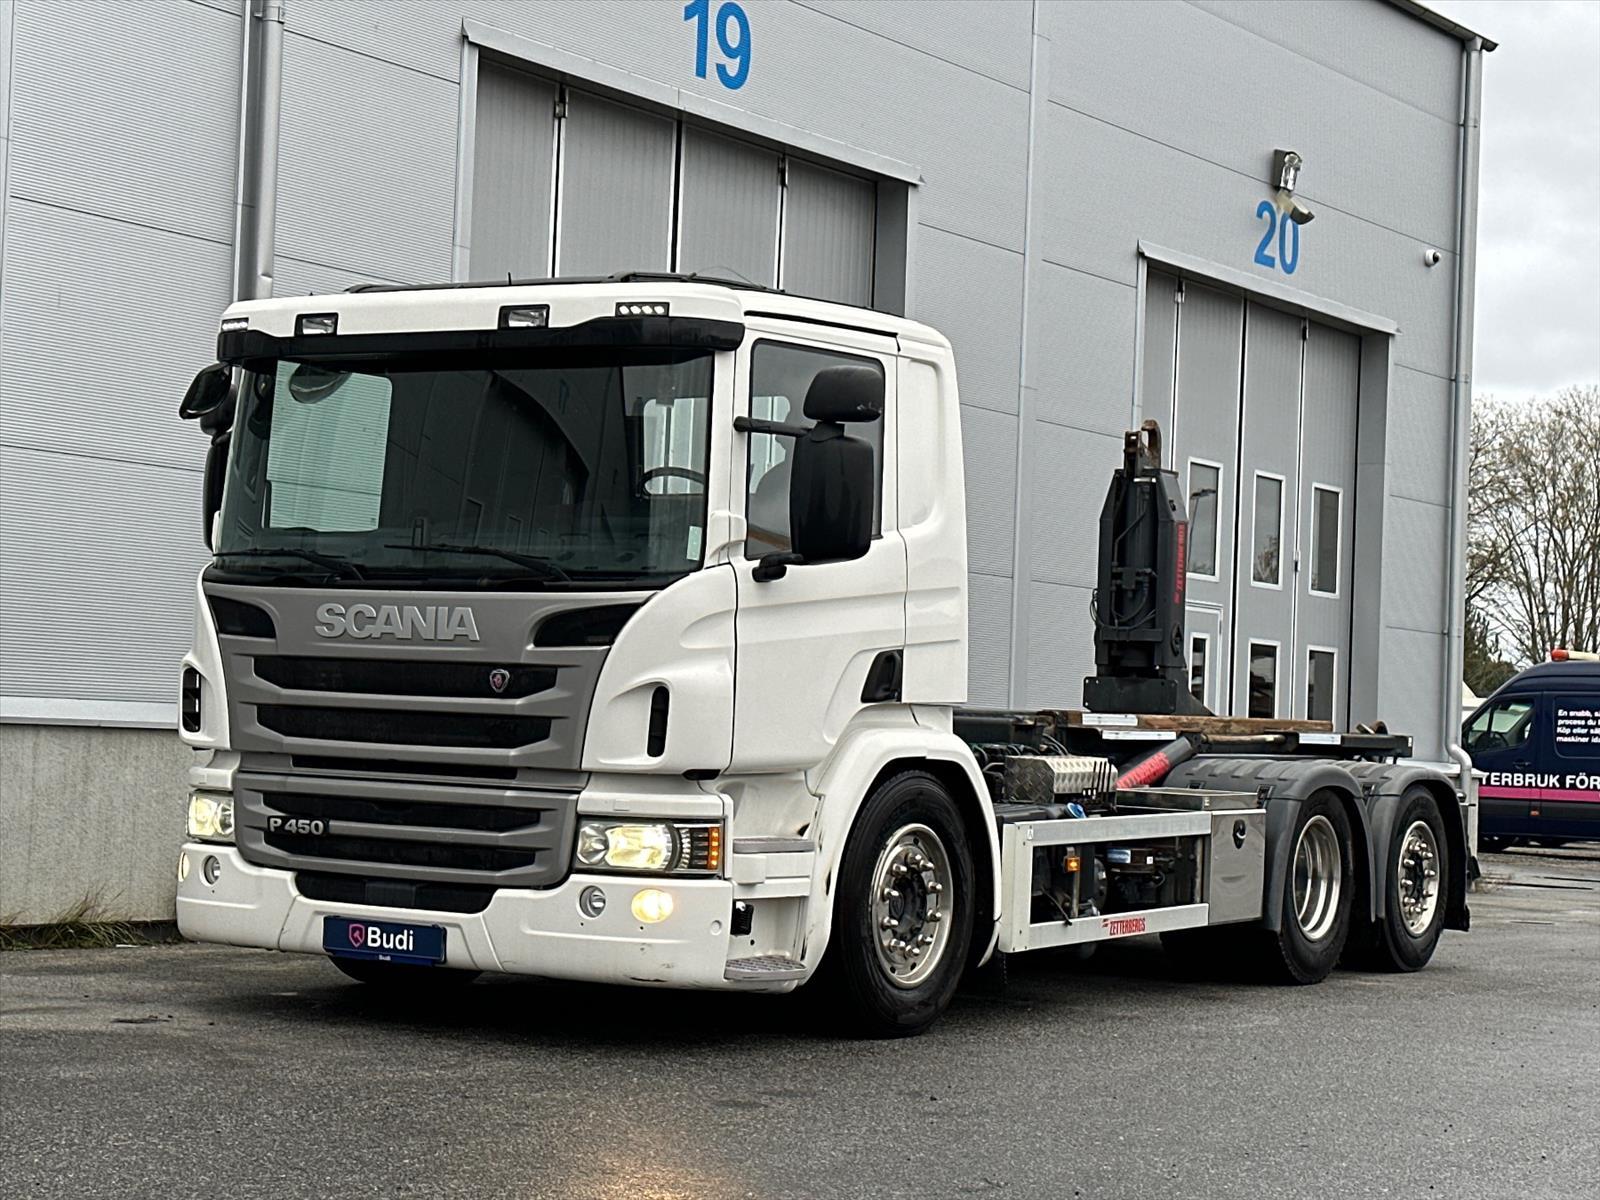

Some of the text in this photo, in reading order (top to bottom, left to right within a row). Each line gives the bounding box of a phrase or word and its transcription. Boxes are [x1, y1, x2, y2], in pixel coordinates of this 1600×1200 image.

[684, 0, 751, 90] 19
[1254, 200, 1300, 274] 20
[314, 603, 480, 642] SCANIA
[1566, 772, 1600, 790] FÖR
[269, 817, 324, 836] P 450
[367, 926, 414, 951] Budi
